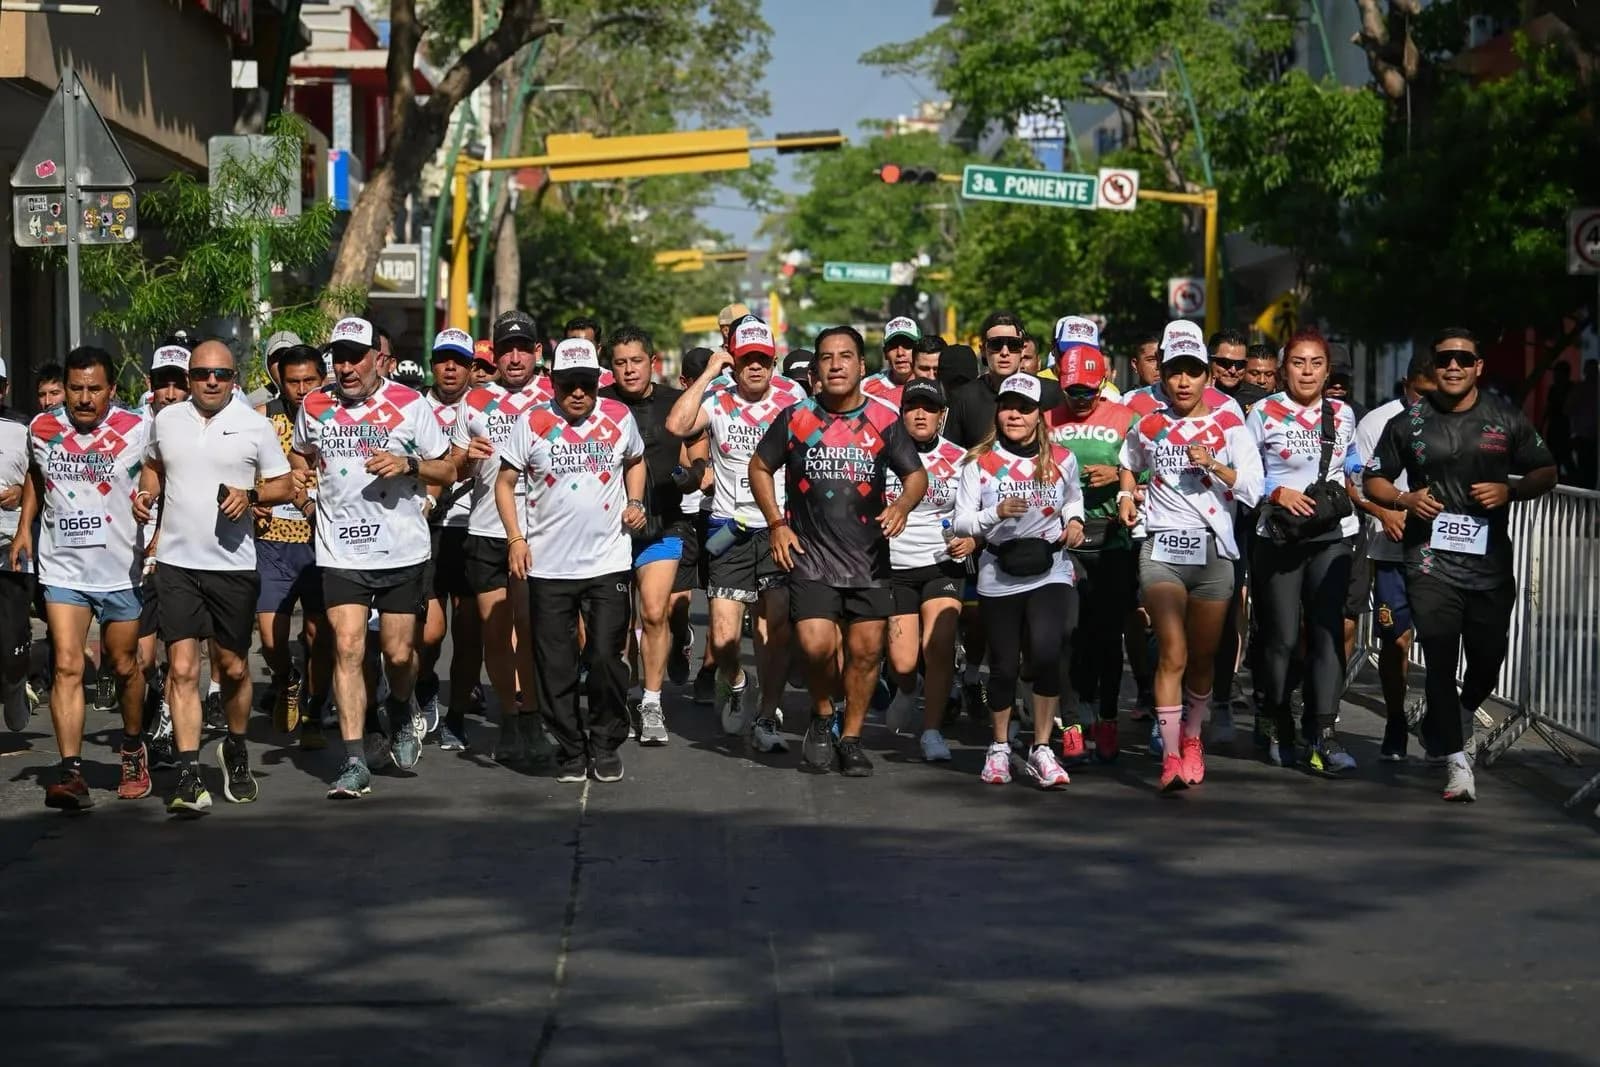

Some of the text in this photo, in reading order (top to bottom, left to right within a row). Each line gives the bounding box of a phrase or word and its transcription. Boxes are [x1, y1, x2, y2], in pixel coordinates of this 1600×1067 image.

[972, 173, 1089, 202] 3a. PONIENTE
[321, 425, 389, 438] CARRERA
[489, 426, 511, 436] POR
[321, 438, 389, 449] POR LA PAZ
[727, 435, 749, 444] POR
[1287, 439, 1308, 448] POR
[337, 449, 365, 457] NUEVA
[551, 442, 613, 455] CARRERA
[806, 446, 875, 462] CARRERA
[49, 450, 114, 463] CARRERA
[551, 454, 615, 467] POR LA PAZ
[1156, 457, 1176, 468] POR
[48, 462, 114, 474] POR LA PAZ
[567, 466, 595, 474] NUEVA
[805, 460, 876, 474] POR LA PAZ
[64, 473, 92, 482] NUEVA
[822, 472, 852, 480] NUEVA
[998, 480, 1056, 492] CARRERA
[1039, 490, 1057, 499] PAZ
[59, 516, 102, 530] 0669
[1437, 521, 1482, 537] 2857
[339, 524, 380, 539] 2697
[1158, 534, 1201, 549] 4892
